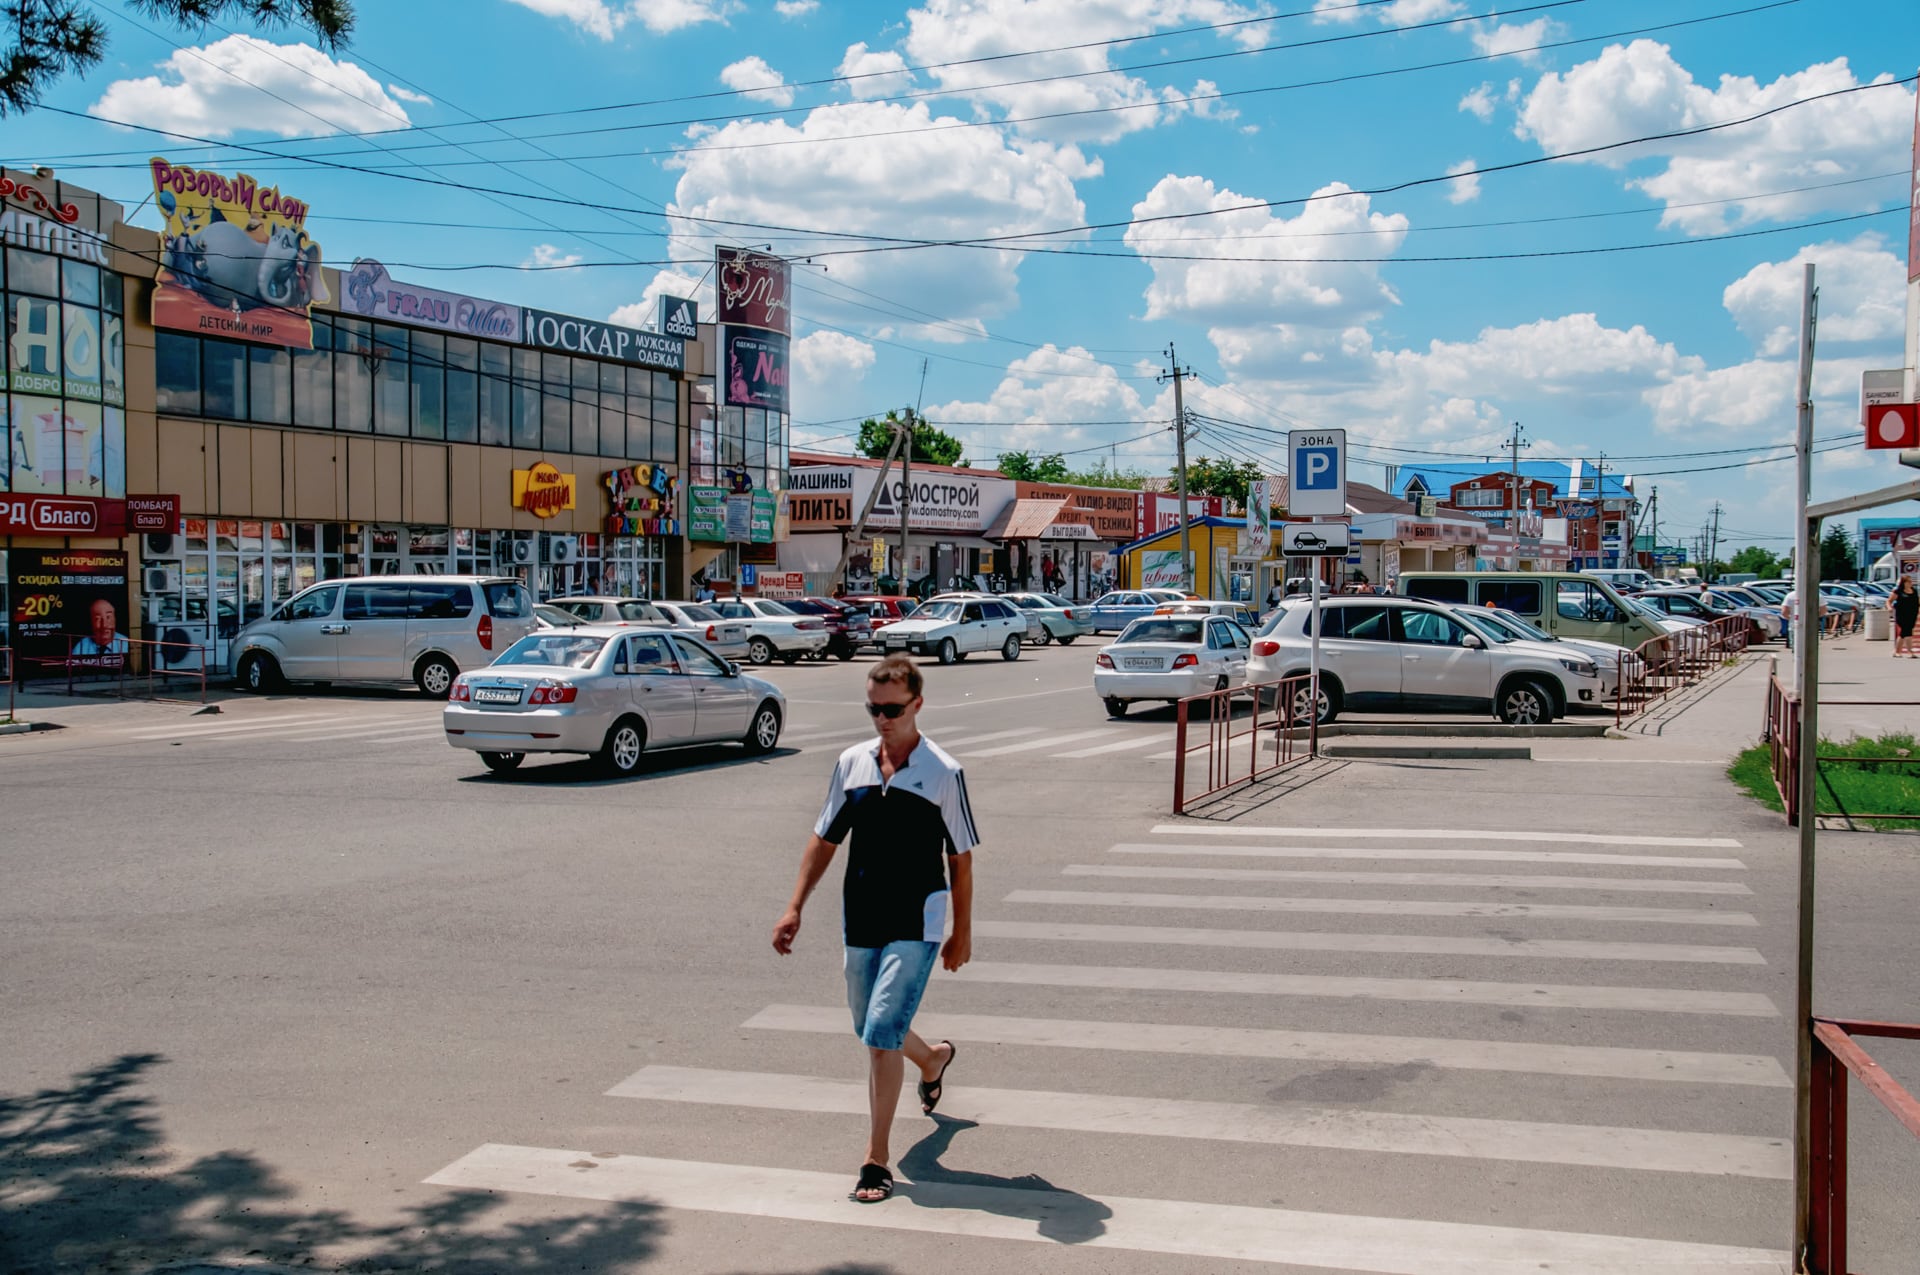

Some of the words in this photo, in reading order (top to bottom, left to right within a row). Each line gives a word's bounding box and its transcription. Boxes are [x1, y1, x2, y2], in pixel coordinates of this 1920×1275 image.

[153, 161, 254, 213] РОЗОВЫЙ
[259, 190, 306, 225] СЛОН
[387, 290, 450, 323] FRAU
[252, 324, 273, 337] МИР
[538, 317, 630, 359] ОСКАР
[666, 322, 696, 337] adidas
[635, 334, 682, 355] МУЖСКАЯ
[638, 350, 680, 368] ОДЕЖДА
[14, 375, 60, 392] ДОБРО
[1300, 436, 1334, 447] ЗОНА
[1306, 452, 1330, 486] P
[620, 463, 668, 495] ВСЕ
[789, 473, 851, 490] МАШИНЫ
[128, 500, 174, 511] ЛОМБАРД
[790, 499, 851, 521] ПЛИТЫ
[1076, 496, 1133, 512] АУДИО-ВИДЕО
[40, 506, 91, 525] Благо
[137, 515, 163, 526] Благо
[1098, 516, 1133, 531] ТЕХНИКА
[1052, 526, 1087, 537] ВЫГОДНЫЙ
[42, 557, 59, 566] МЫ
[18, 576, 60, 586] СКИДКА
[1144, 568, 1186, 587] цвет
[18, 595, 63, 616] -20%
